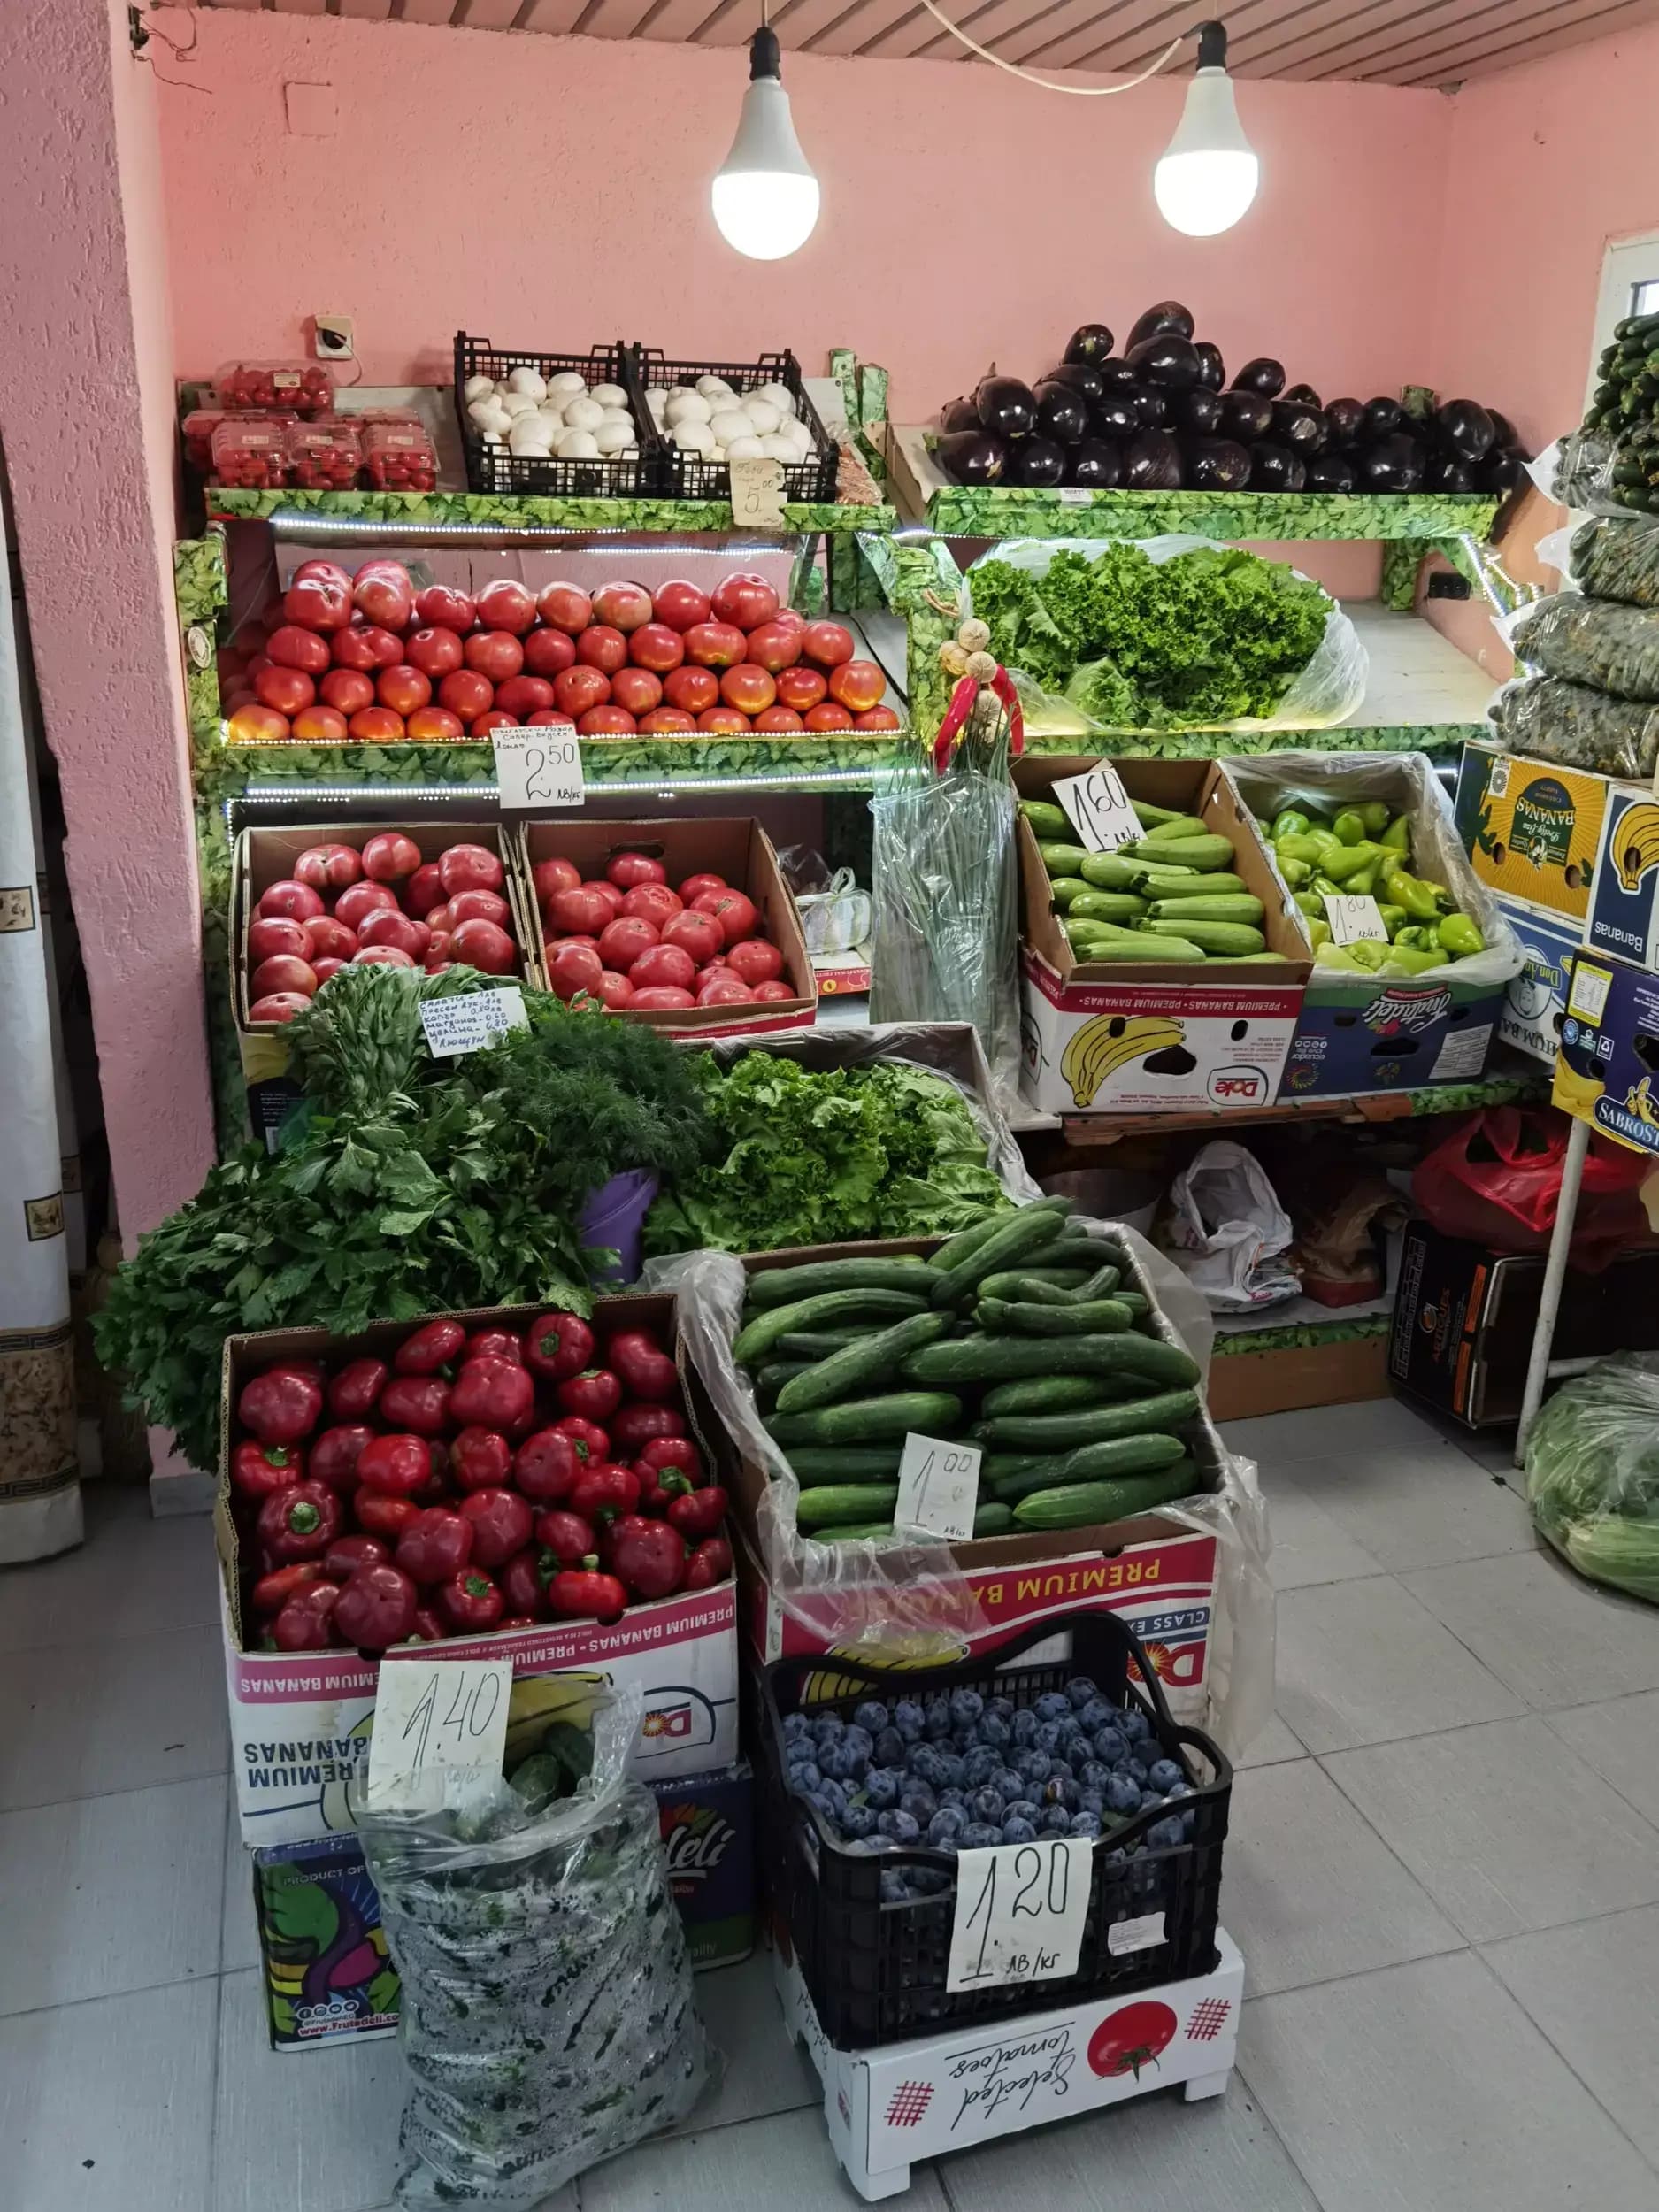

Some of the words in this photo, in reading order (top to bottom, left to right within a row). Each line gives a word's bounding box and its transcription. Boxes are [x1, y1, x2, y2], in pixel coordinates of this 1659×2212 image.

[1516, 796, 1575, 825] BANANAS
[1594, 921, 1643, 952] Bananas
[1540, 967, 1558, 986] Don
[1084, 996, 1133, 1007] BANANAS
[1134, 998, 1182, 1009] PREMIUM
[1188, 1000, 1235, 1010] BANANAS
[1237, 1001, 1281, 1011] PREMIUM
[1215, 1079, 1258, 1097] Dole
[1018, 1558, 1161, 1601] PREMIUM
[666, 1605, 733, 1635] PREMIUM
[1153, 1610, 1206, 1630] CLASS
[588, 1624, 662, 1652] BANANAS
[241, 1677, 321, 1693] BANANAS
[244, 1737, 367, 1763] BANANAS
[284, 1868, 343, 1885] PRODUCT
[348, 1865, 365, 1874] OF
[949, 2030, 1071, 2088] tomatoes
[950, 2054, 1077, 2131] Selected
